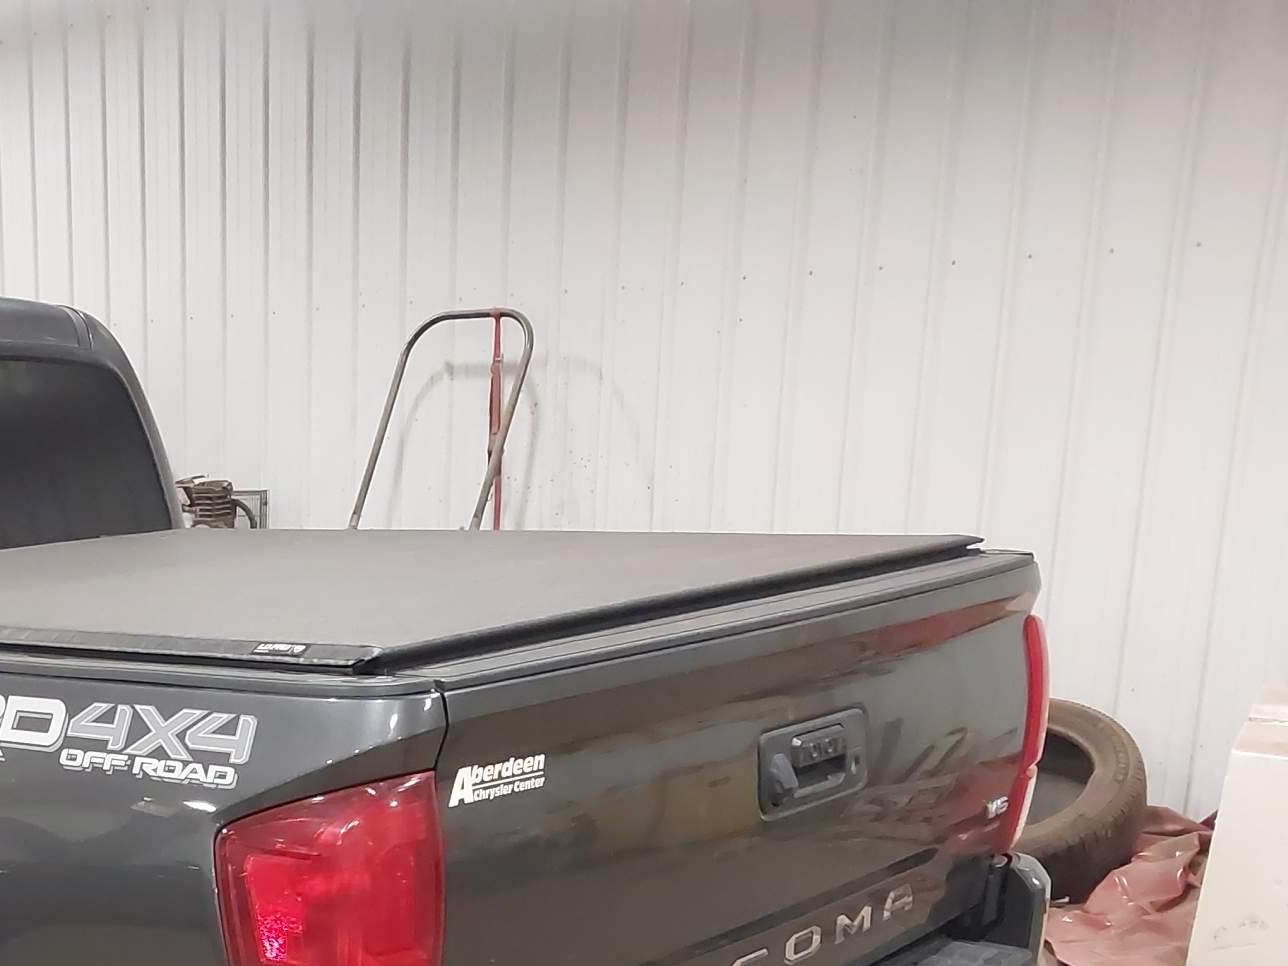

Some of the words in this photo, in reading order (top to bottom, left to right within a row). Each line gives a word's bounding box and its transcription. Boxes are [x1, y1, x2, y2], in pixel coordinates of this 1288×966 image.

[59, 748, 132, 774] OFF
[132, 757, 238, 789] ROAD
[448, 754, 545, 807] Aberdeen
[473, 783, 513, 800] Chrysler
[513, 777, 545, 792] Center
